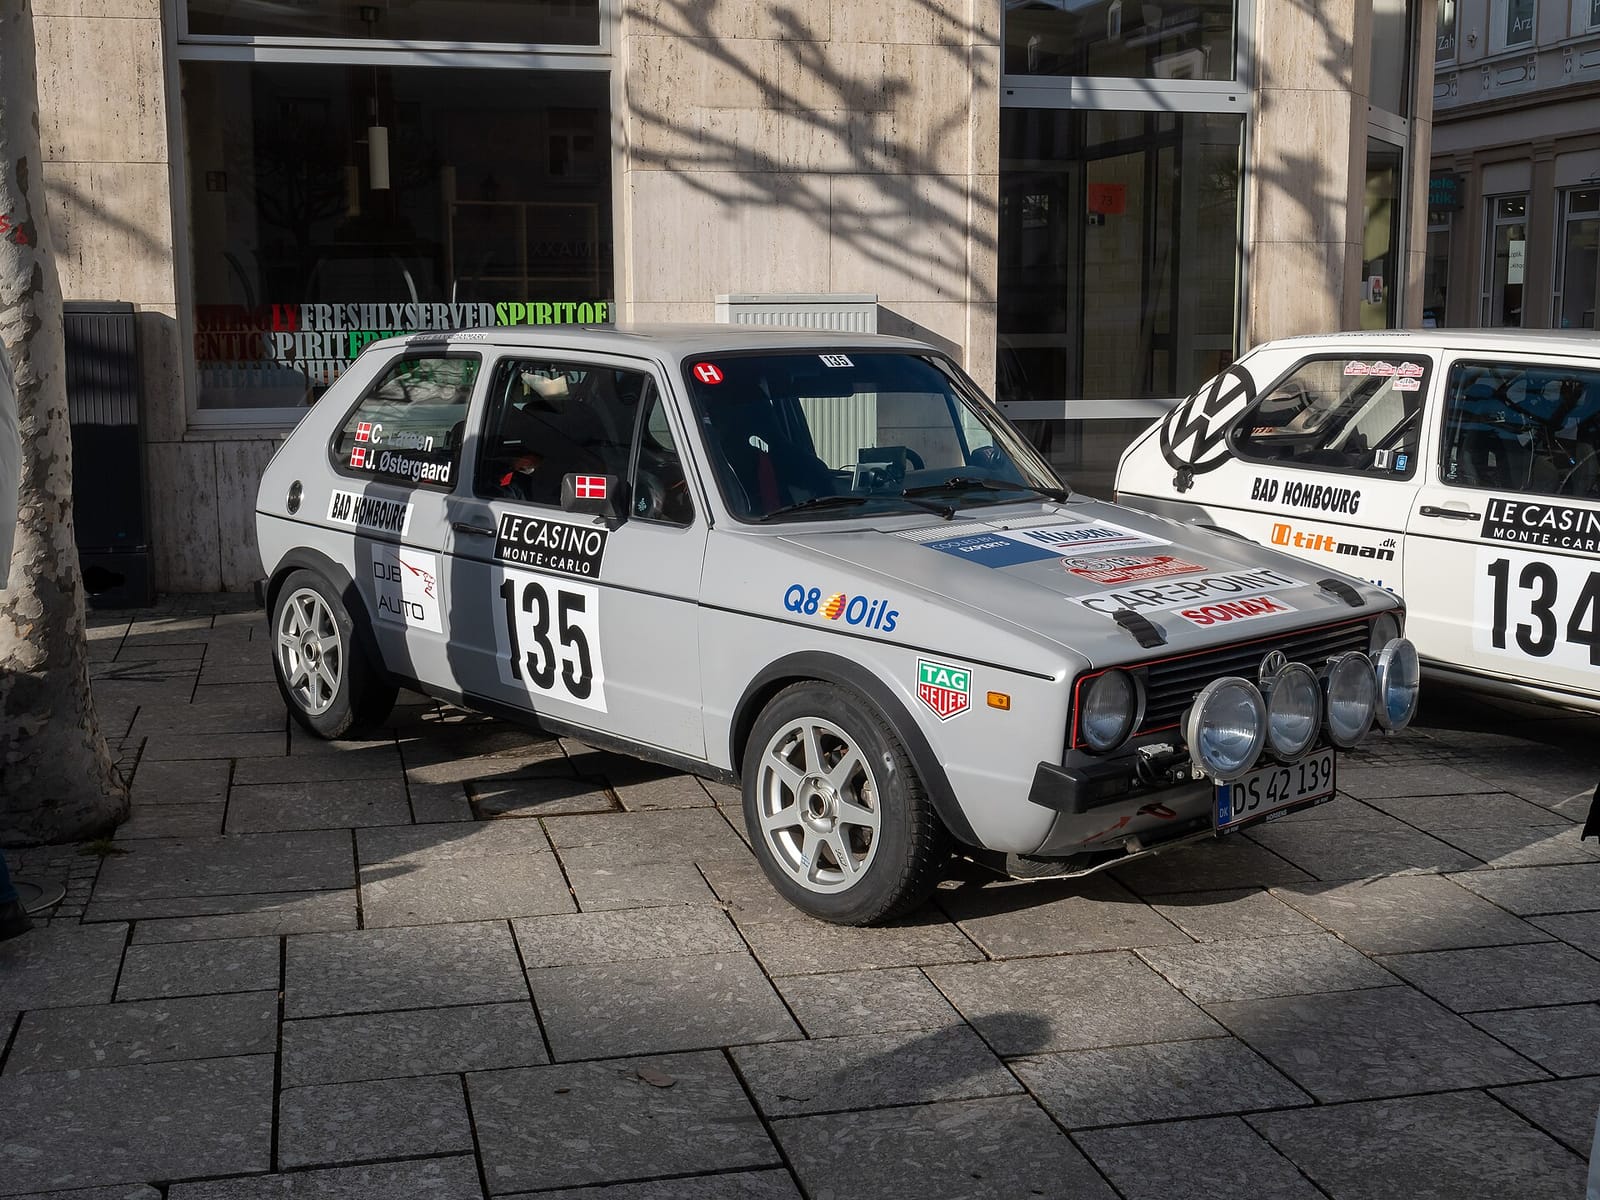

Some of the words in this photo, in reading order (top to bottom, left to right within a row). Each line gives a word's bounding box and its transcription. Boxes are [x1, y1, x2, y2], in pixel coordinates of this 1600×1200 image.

[699, 365, 721, 382] H
[823, 355, 849, 367] 135
[371, 423, 383, 445] C.
[365, 449, 376, 470] J.
[379, 451, 452, 483] Østergaard
[1250, 477, 1279, 503] BAD
[1280, 481, 1361, 515] HOMBOURG
[331, 492, 351, 521] BAD
[352, 496, 407, 533] HOMBOURG
[1490, 500, 1516, 524] LE
[500, 516, 524, 543] LE
[524, 519, 603, 557] CASINO
[1293, 530, 1396, 561] tiltman
[373, 561, 401, 583] DJB
[378, 595, 425, 621] AUTO
[784, 583, 820, 615] Q8
[845, 594, 899, 633] Oils
[1187, 596, 1288, 626] SONAX
[1487, 558, 1600, 668] 134
[500, 578, 595, 702] 135
[921, 664, 965, 687] TAG
[920, 683, 969, 717] HEUER
[1233, 777, 1260, 816] DS
[1266, 768, 1291, 803] 42
[1297, 756, 1331, 795] 139
[1219, 806, 1229, 818] DK
